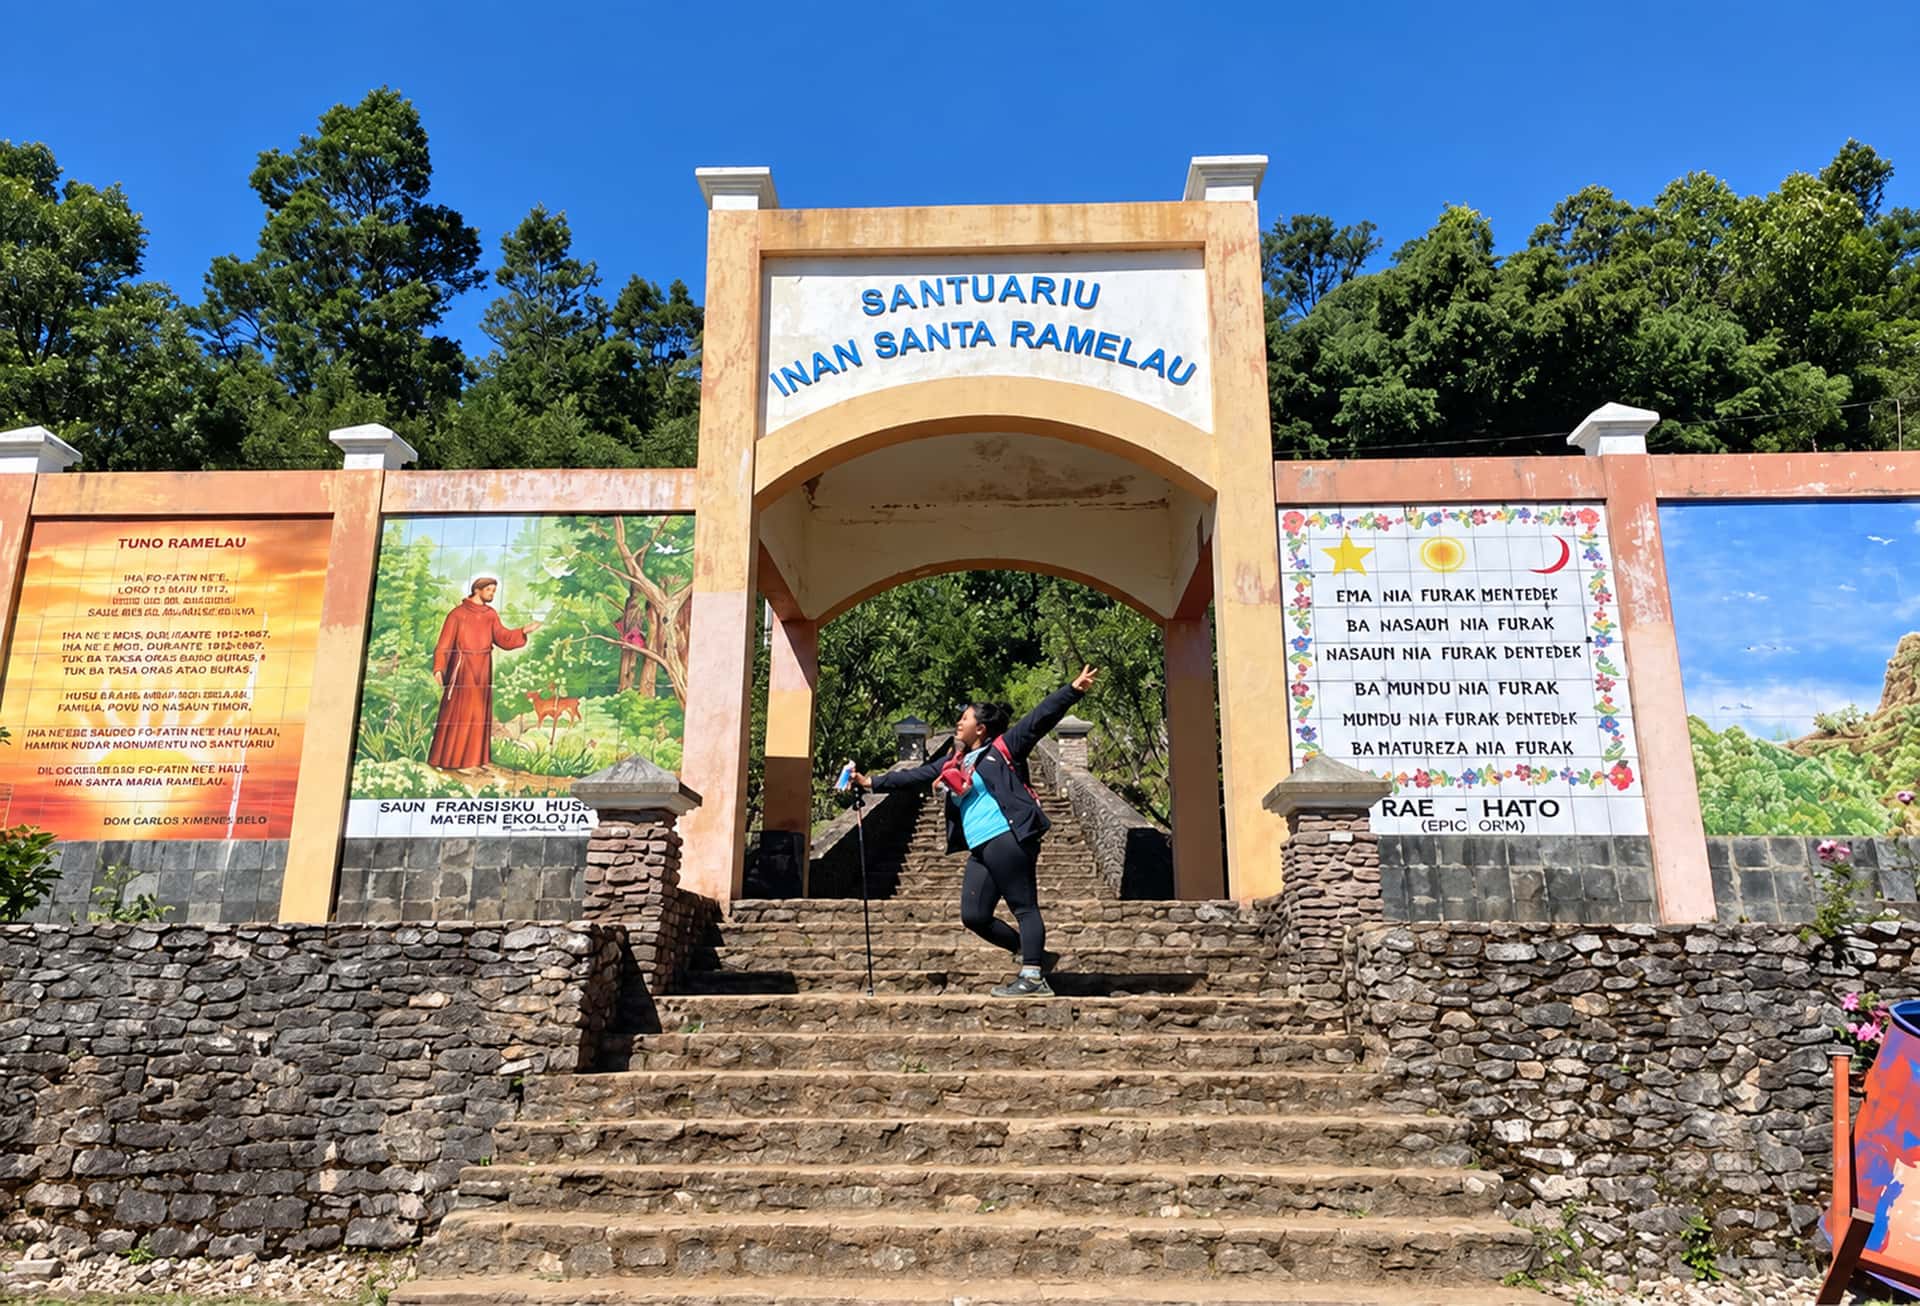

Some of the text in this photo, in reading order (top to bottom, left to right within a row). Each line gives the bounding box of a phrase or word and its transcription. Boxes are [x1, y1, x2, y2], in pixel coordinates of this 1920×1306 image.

[862, 274, 1101, 316] SANTUARIU
[769, 320, 1198, 397] INAN SANTA RAMELAU
[118, 537, 247, 549] TUNO RAMELAU
[1336, 589, 1372, 602] EMA
[1383, 589, 1412, 602] NIA
[1421, 588, 1476, 602] FURAK
[1346, 616, 1555, 632] BA NASAUN NIA FURAK
[62, 631, 82, 640] IHA
[62, 643, 81, 651] IHA
[1326, 645, 1582, 661] NASAUN NIA FURAK DENTEDEK
[64, 667, 86, 675] TUK
[89, 667, 105, 675] BA
[1355, 681, 1559, 696] BA MUNDU NIA FURAK
[142, 703, 159, 711] NO
[162, 703, 209, 711] NASAUN
[1343, 711, 1577, 726] MUNDU NIA FURAK DENTEDEK
[27, 729, 46, 737] IHA
[218, 728, 241, 736] HAU
[71, 741, 111, 750] NUDAR
[113, 740, 188, 749] MONUMENTU
[190, 740, 207, 748] NO
[209, 739, 275, 748] SANTUARIU
[1352, 741, 1574, 756] BA NATUREZA NIA FURAK
[55, 778, 82, 787] INAN
[85, 778, 122, 787] SANTA
[126, 777, 162, 786] MARIA
[379, 801, 426, 813] SAUN
[435, 800, 535, 813] FRANSISKU
[1382, 799, 1435, 817] RAE
[1483, 799, 1560, 817] HATO
[103, 816, 130, 825] DOM
[133, 816, 180, 825] CARLOS
[430, 813, 589, 825] MA'EREN EKOLOJIA
[1421, 819, 1467, 833] (EPIC
